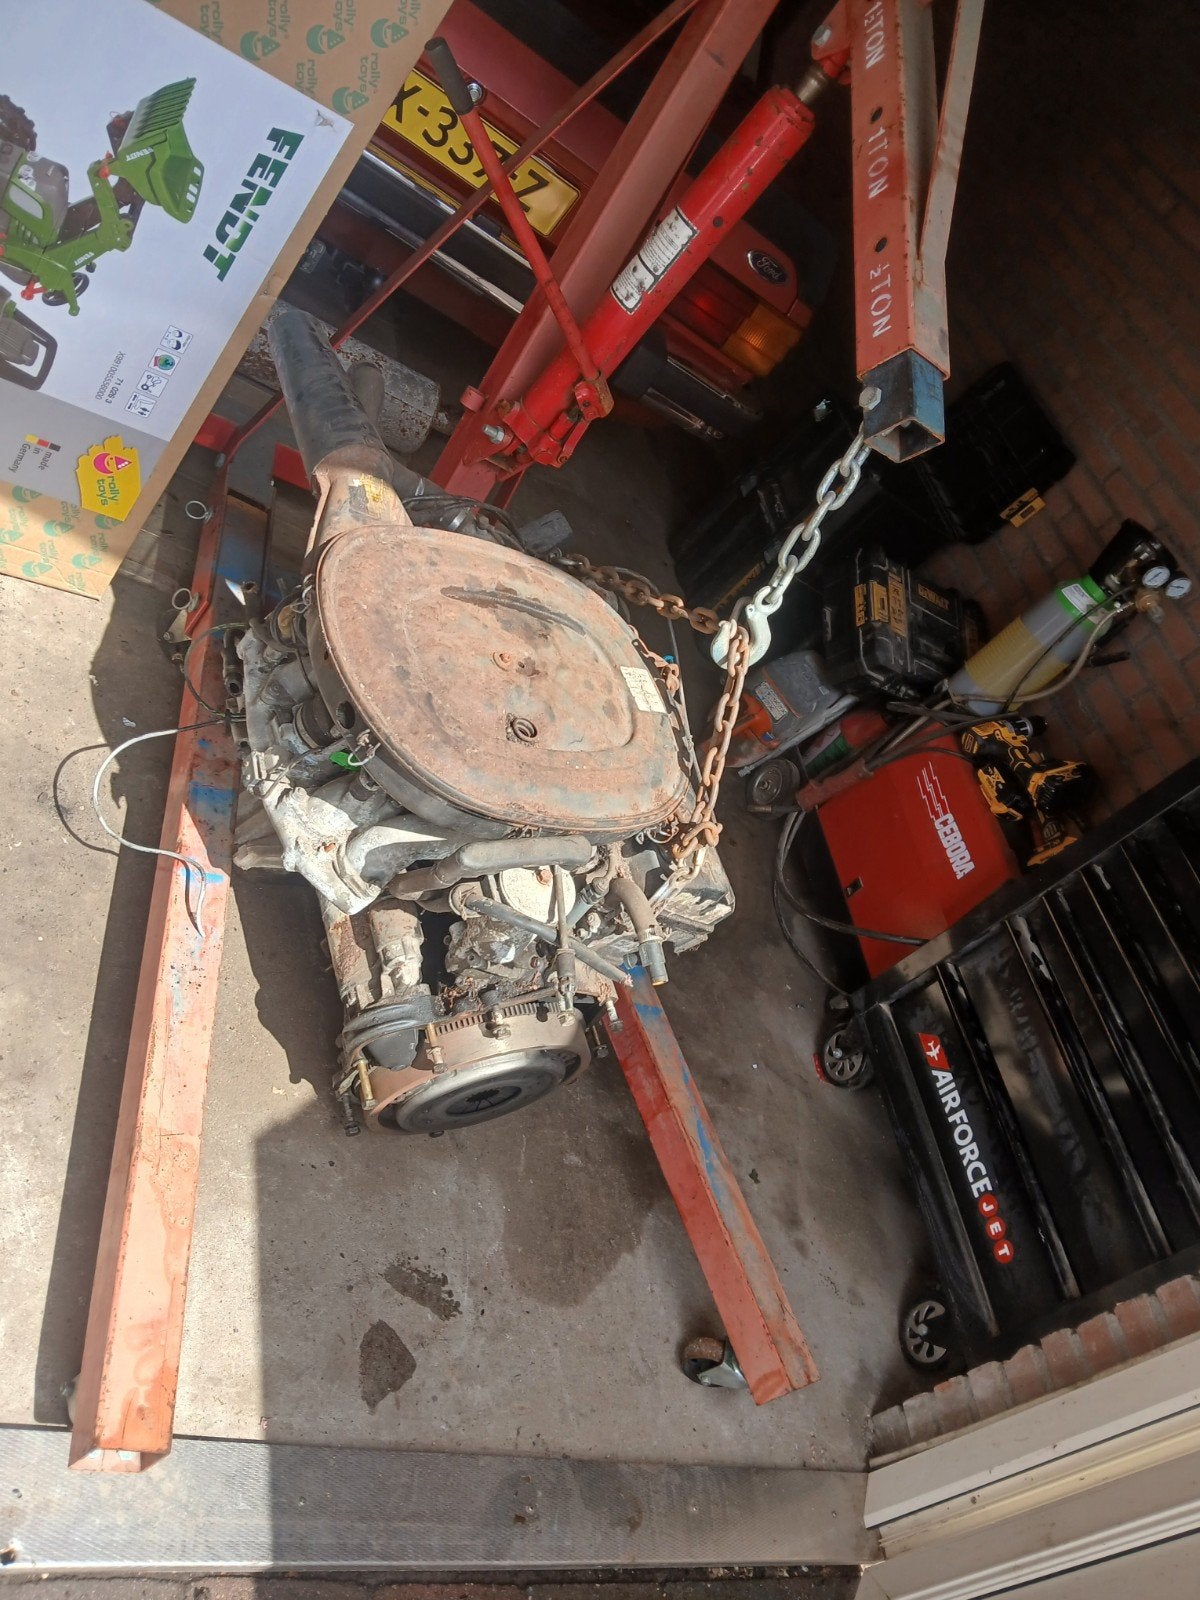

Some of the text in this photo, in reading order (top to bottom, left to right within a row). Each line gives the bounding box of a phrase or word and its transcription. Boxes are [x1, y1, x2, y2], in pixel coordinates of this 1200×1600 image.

[200, 5, 210, 36] toy
[295, 62, 305, 91] toy
[358, 56, 368, 93] toys
[369, 53, 381, 88] rolly
[203, 126, 305, 282] FENDT
[755, 255, 782, 280] Ford
[8, 444, 31, 474] Germany
[40, 452, 52, 471] made
[97, 479, 108, 506] toys
[107, 476, 119, 502] rolly
[933, 812, 976, 880] CEBORA
